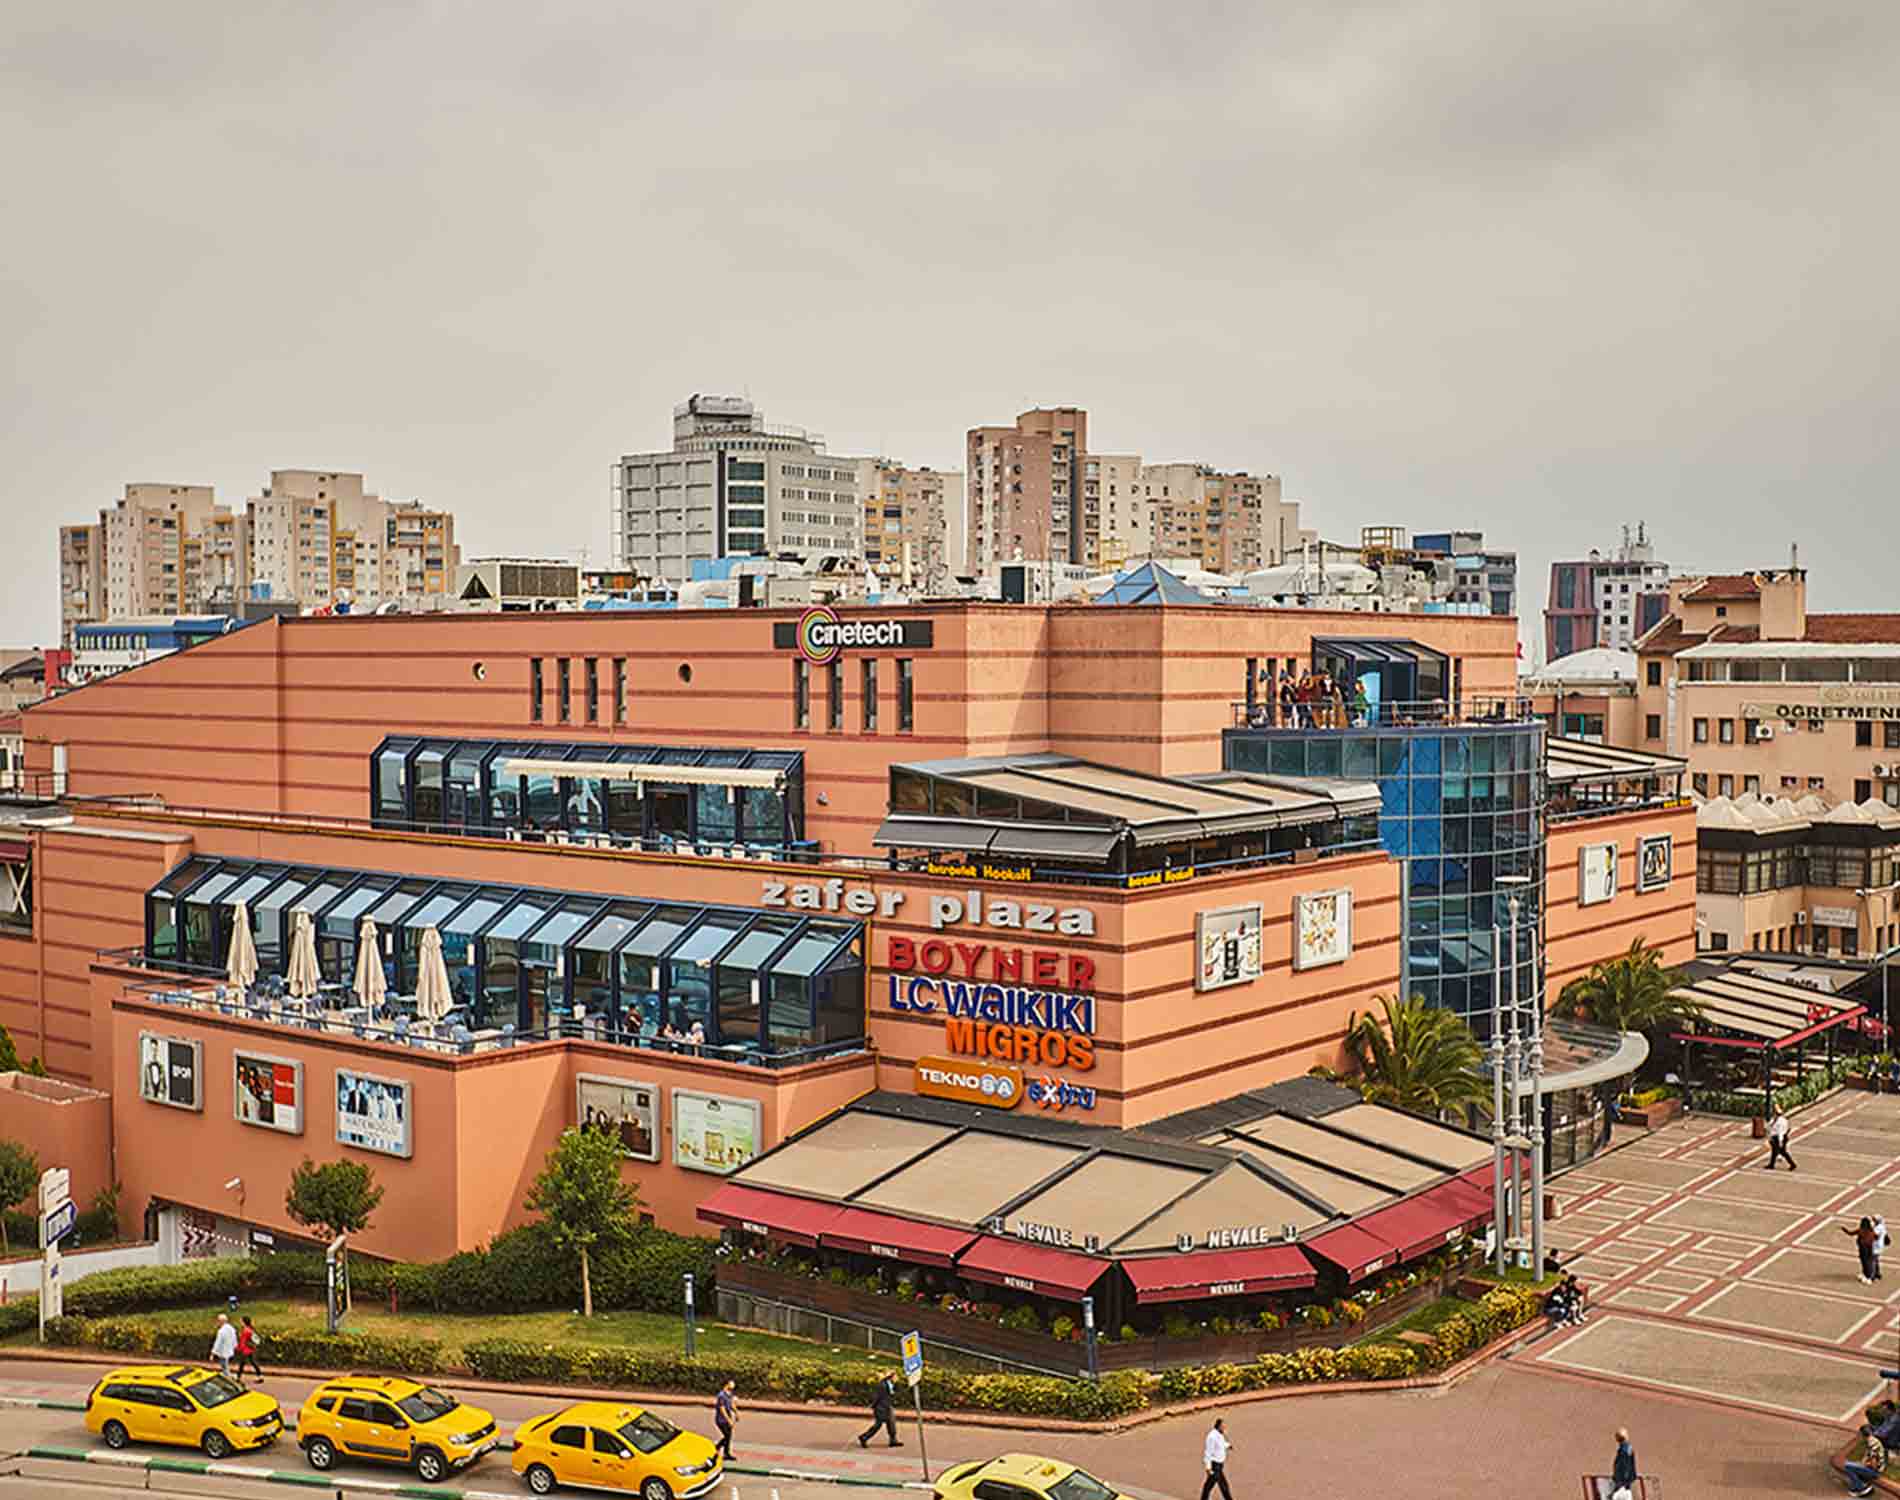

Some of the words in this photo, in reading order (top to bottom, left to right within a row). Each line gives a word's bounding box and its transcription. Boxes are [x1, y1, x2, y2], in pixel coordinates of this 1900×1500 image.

[810, 620, 904, 645] cinetech
[760, 878, 904, 917] zafer
[930, 890, 1095, 936] plaza
[888, 936, 1096, 991] BOYNER
[919, 1068, 1014, 1099] TEKNOSA
[1027, 1076, 1096, 1111] extra
[1017, 1221, 1072, 1247] NEVALE
[1208, 1227, 1270, 1248] NEVALE
[1210, 1282, 1246, 1295] NEVALE
